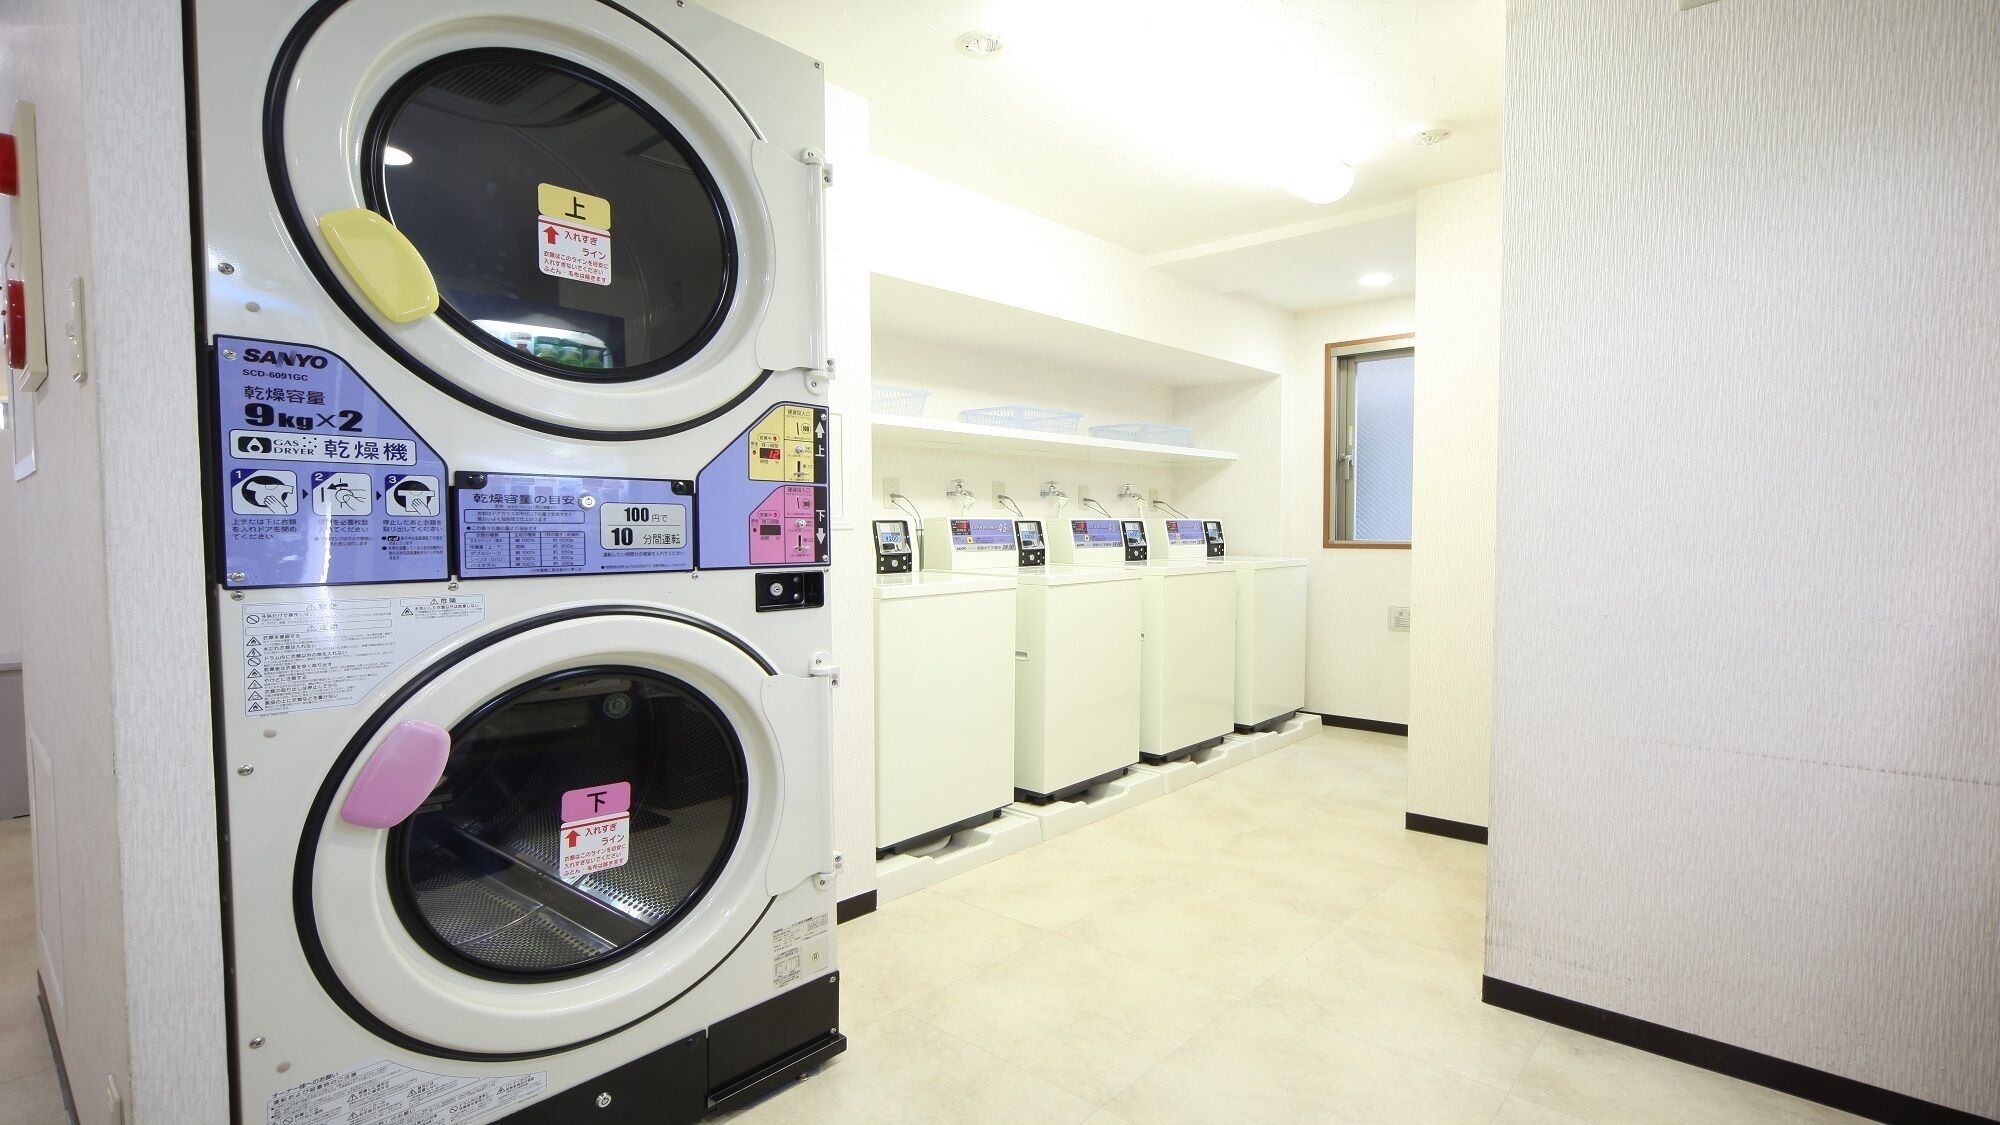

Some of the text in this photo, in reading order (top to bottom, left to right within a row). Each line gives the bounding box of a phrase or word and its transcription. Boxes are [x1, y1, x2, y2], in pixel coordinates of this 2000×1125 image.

[565, 196, 586, 220] 上
[564, 231, 598, 246] 入れすぎ
[582, 248, 606, 260] ライン
[544, 259, 604, 275] 入れすぎないでください
[242, 348, 328, 369] SANYO
[242, 369, 308, 382] SCD-6091GC
[244, 386, 324, 405] 乾燥容量
[273, 439, 299, 447] GAS
[273, 446, 314, 455] DRYER
[324, 440, 408, 462] 乾燥機
[768, 450, 780, 458] 12
[816, 444, 825, 457] 上
[235, 470, 242, 479] 1
[314, 473, 324, 482] 2
[388, 476, 397, 484] 3
[473, 493, 575, 505] 乾燥容量の目安
[816, 510, 825, 522] 下
[611, 527, 681, 546] 10 分間運転
[587, 791, 607, 813] 下
[585, 822, 617, 837] 入れすぎ
[602, 834, 625, 846] ライン
